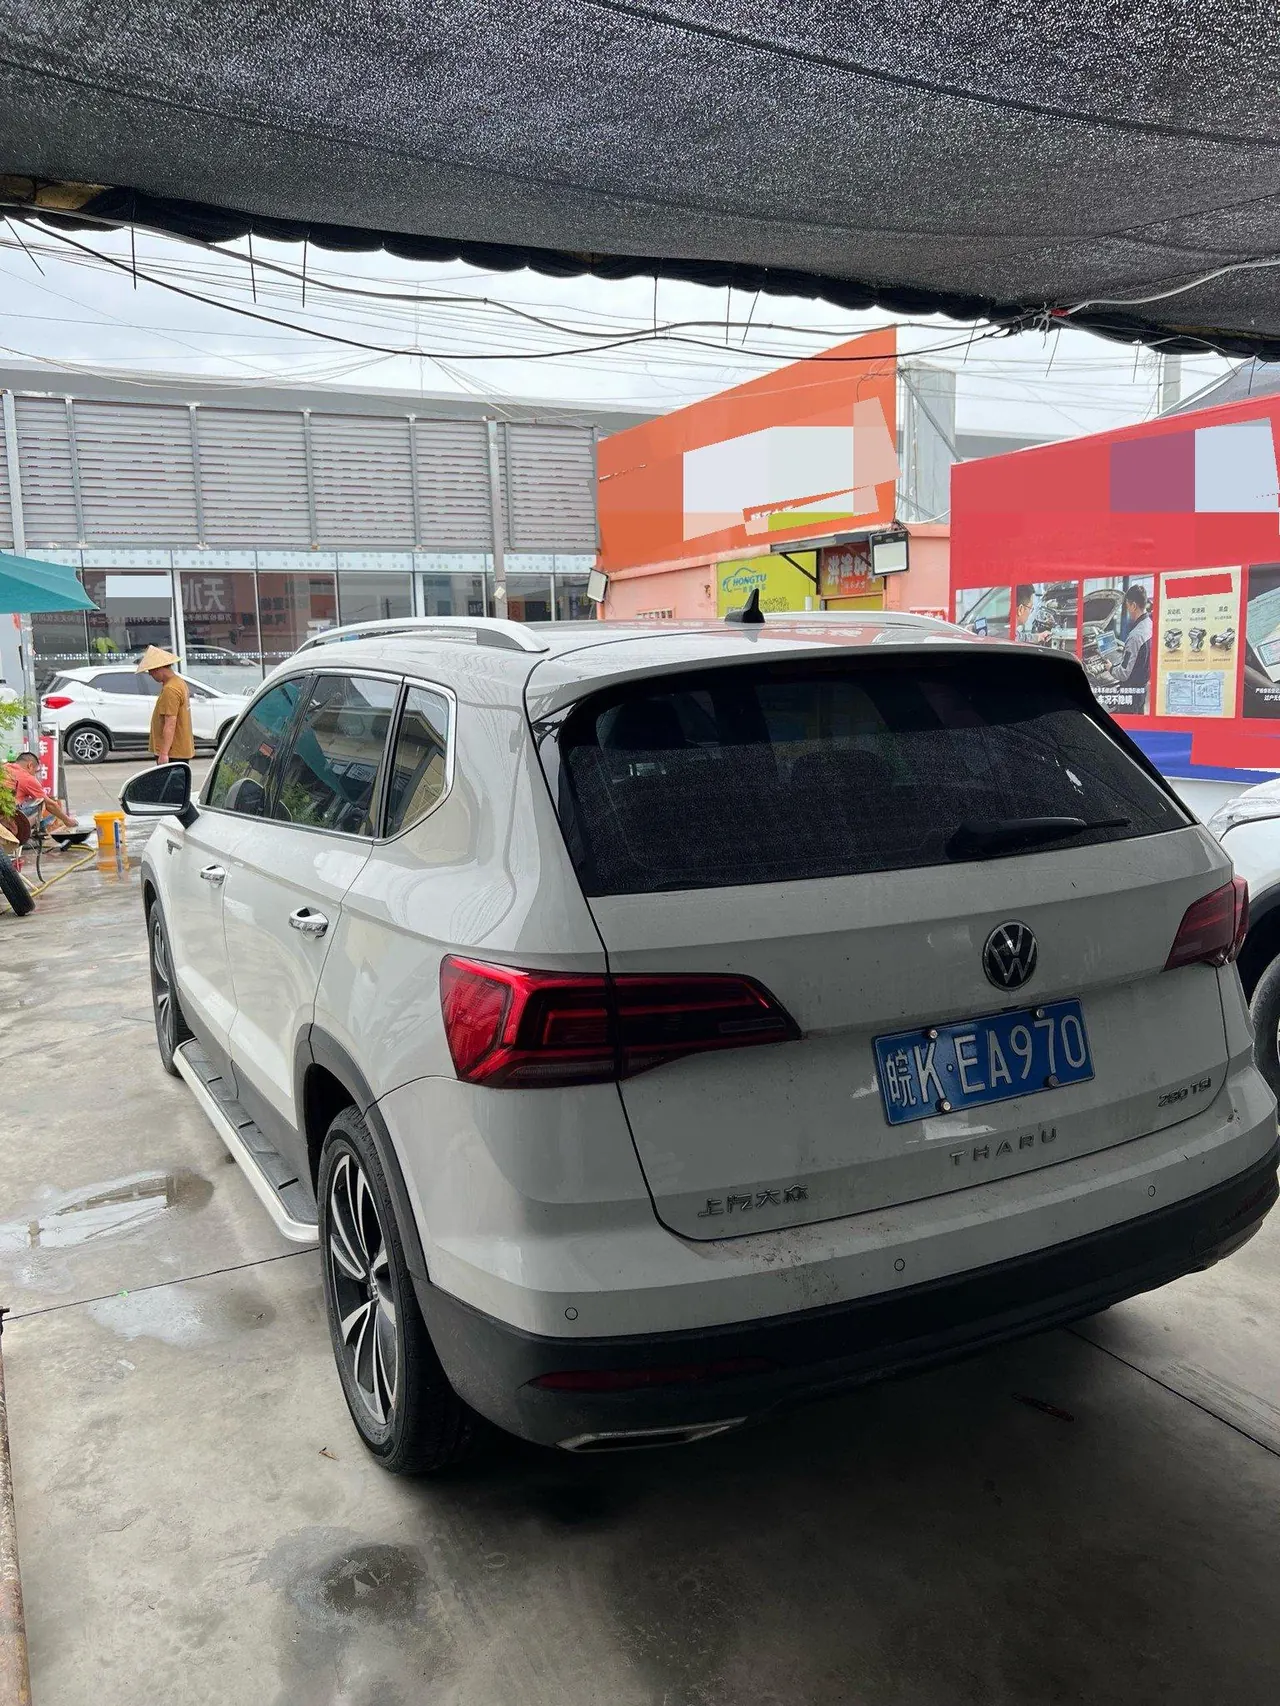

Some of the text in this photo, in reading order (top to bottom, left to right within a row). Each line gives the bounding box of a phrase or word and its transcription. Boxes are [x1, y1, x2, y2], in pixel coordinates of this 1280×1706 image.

[733, 573, 767, 586] HONGTU
[1190, 1076, 1212, 1095] TSI
[950, 1128, 1057, 1166] THARU
[698, 1184, 808, 1217] 上汽大众
